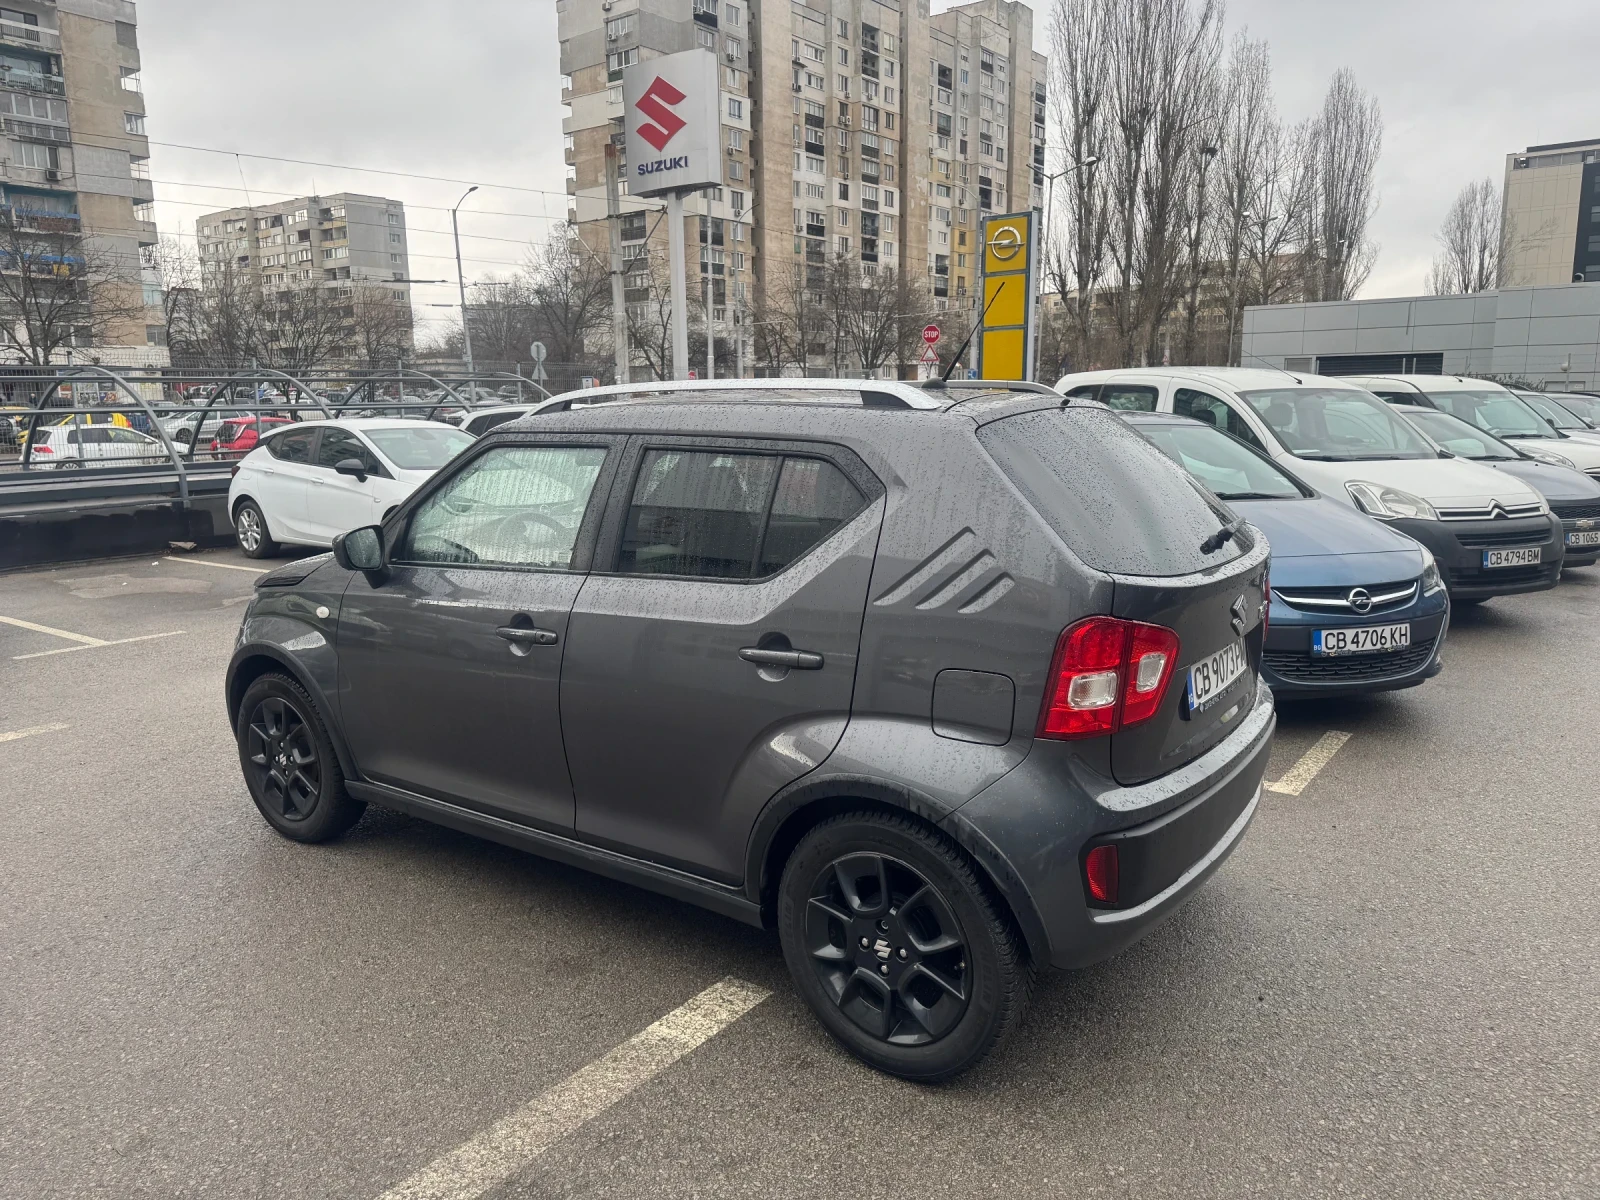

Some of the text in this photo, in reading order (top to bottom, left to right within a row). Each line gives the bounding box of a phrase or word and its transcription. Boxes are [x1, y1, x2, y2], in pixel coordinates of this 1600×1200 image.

[637, 156, 689, 176] SUZUKI
[1582, 532, 1599, 544] 1065
[1489, 552, 1503, 566] CB
[1504, 550, 1526, 565] 4794
[1325, 632, 1347, 650] CB
[1351, 628, 1388, 649] 4706
[1390, 626, 1408, 645] KH
[1194, 662, 1212, 700] CB
[1212, 645, 1236, 689] 9073
